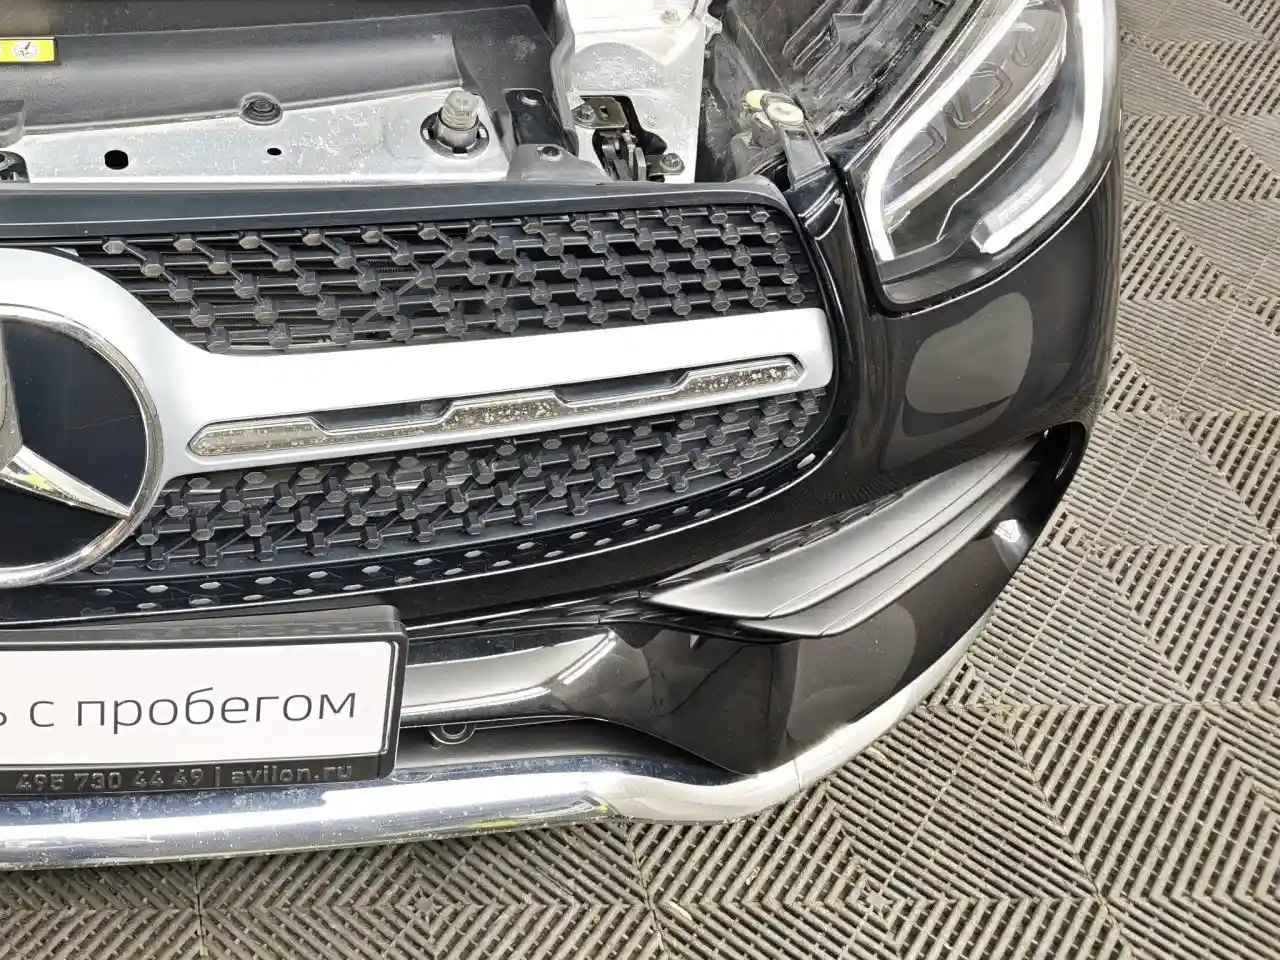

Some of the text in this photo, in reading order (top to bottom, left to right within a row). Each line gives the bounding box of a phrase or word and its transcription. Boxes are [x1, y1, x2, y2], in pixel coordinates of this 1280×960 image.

[29, 700, 55, 727] с
[76, 687, 356, 734] пробегом
[15, 773, 65, 791] 495
[73, 771, 122, 790] 730
[130, 770, 164, 787] 44
[173, 768, 204, 787] 49
[231, 764, 352, 784] avilon.ru
